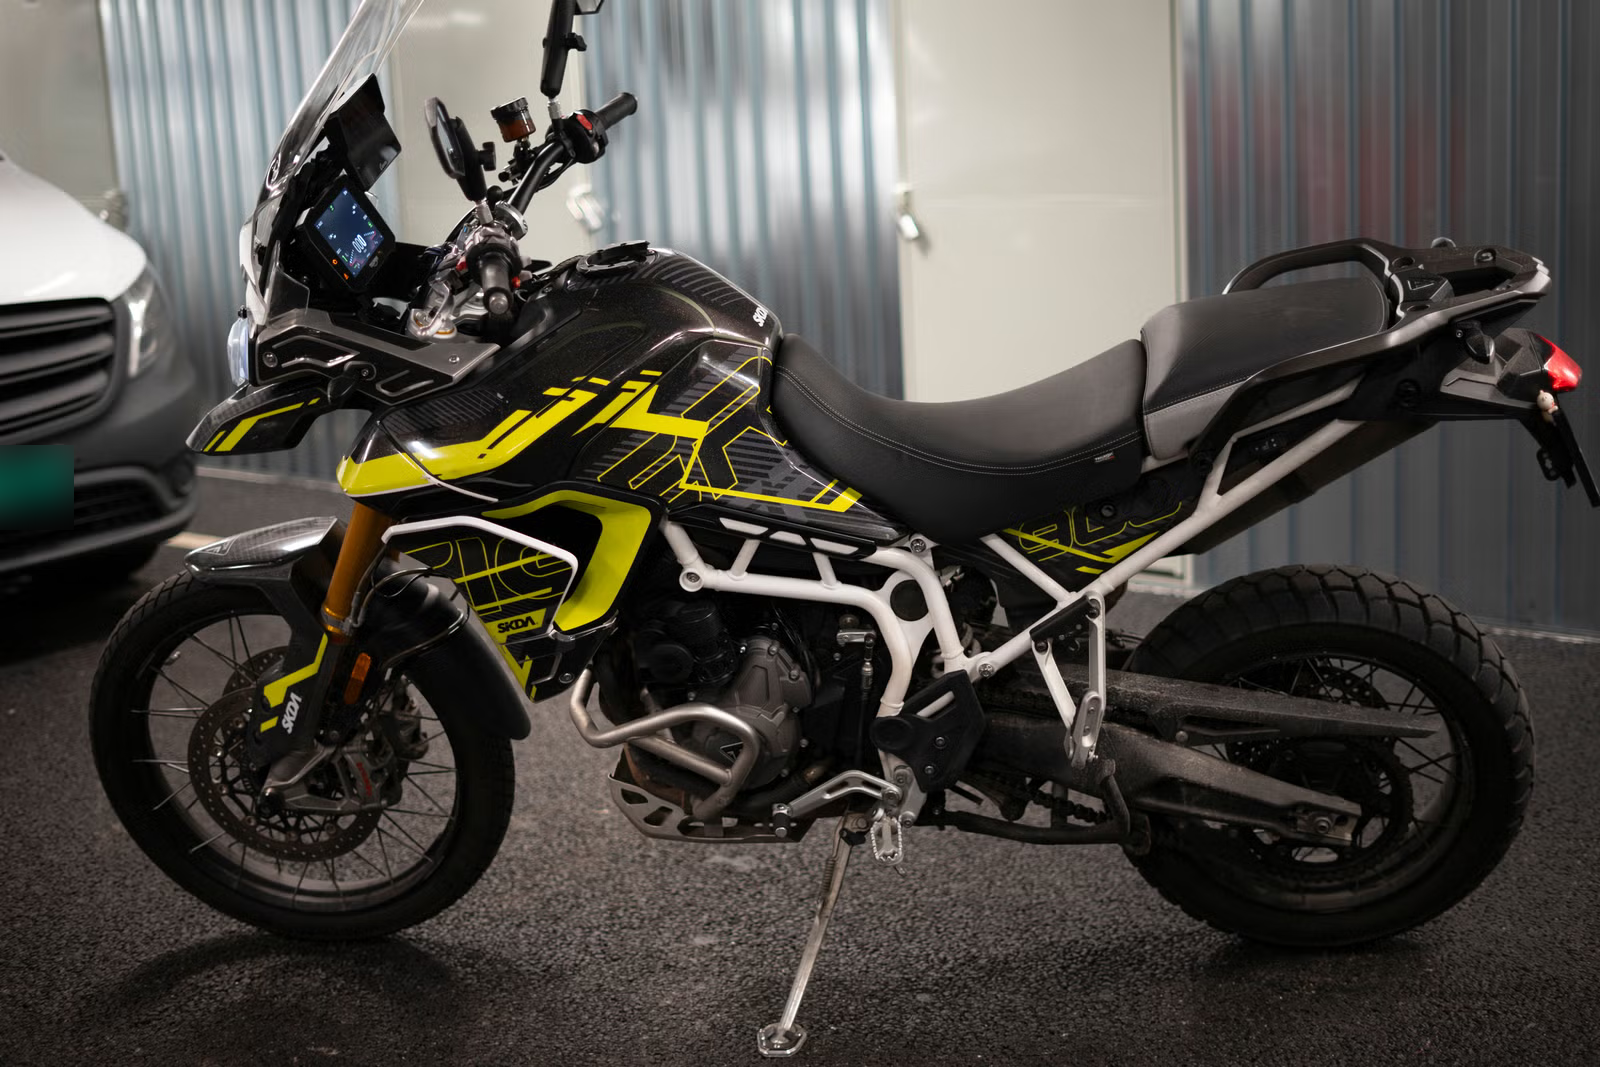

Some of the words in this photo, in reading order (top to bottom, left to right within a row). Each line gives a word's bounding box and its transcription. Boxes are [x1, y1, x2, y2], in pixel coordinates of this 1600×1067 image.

[753, 306, 768, 327] SKD
[498, 616, 536, 633] SKDA
[281, 692, 302, 734] SKDA
